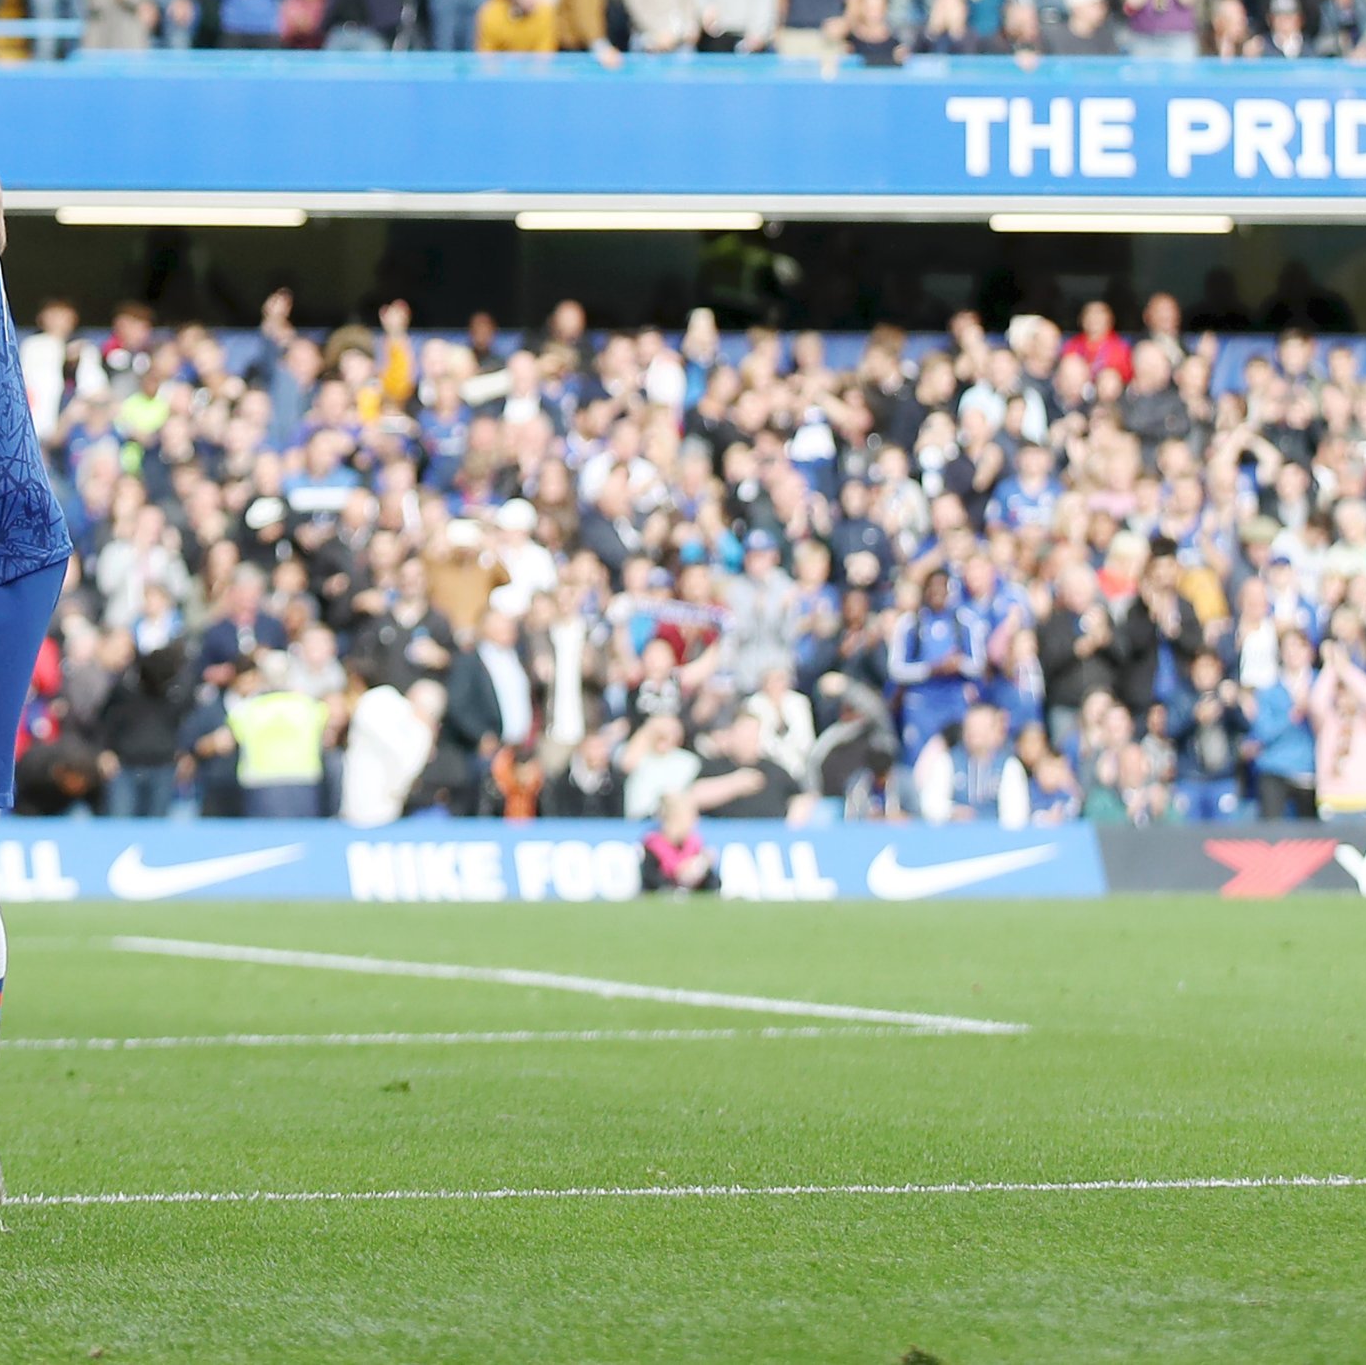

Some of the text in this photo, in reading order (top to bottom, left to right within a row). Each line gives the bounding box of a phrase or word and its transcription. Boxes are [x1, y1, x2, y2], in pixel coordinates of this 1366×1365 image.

[946, 97, 1135, 177] THE
[346, 839, 839, 903] NIKE FOOALL
